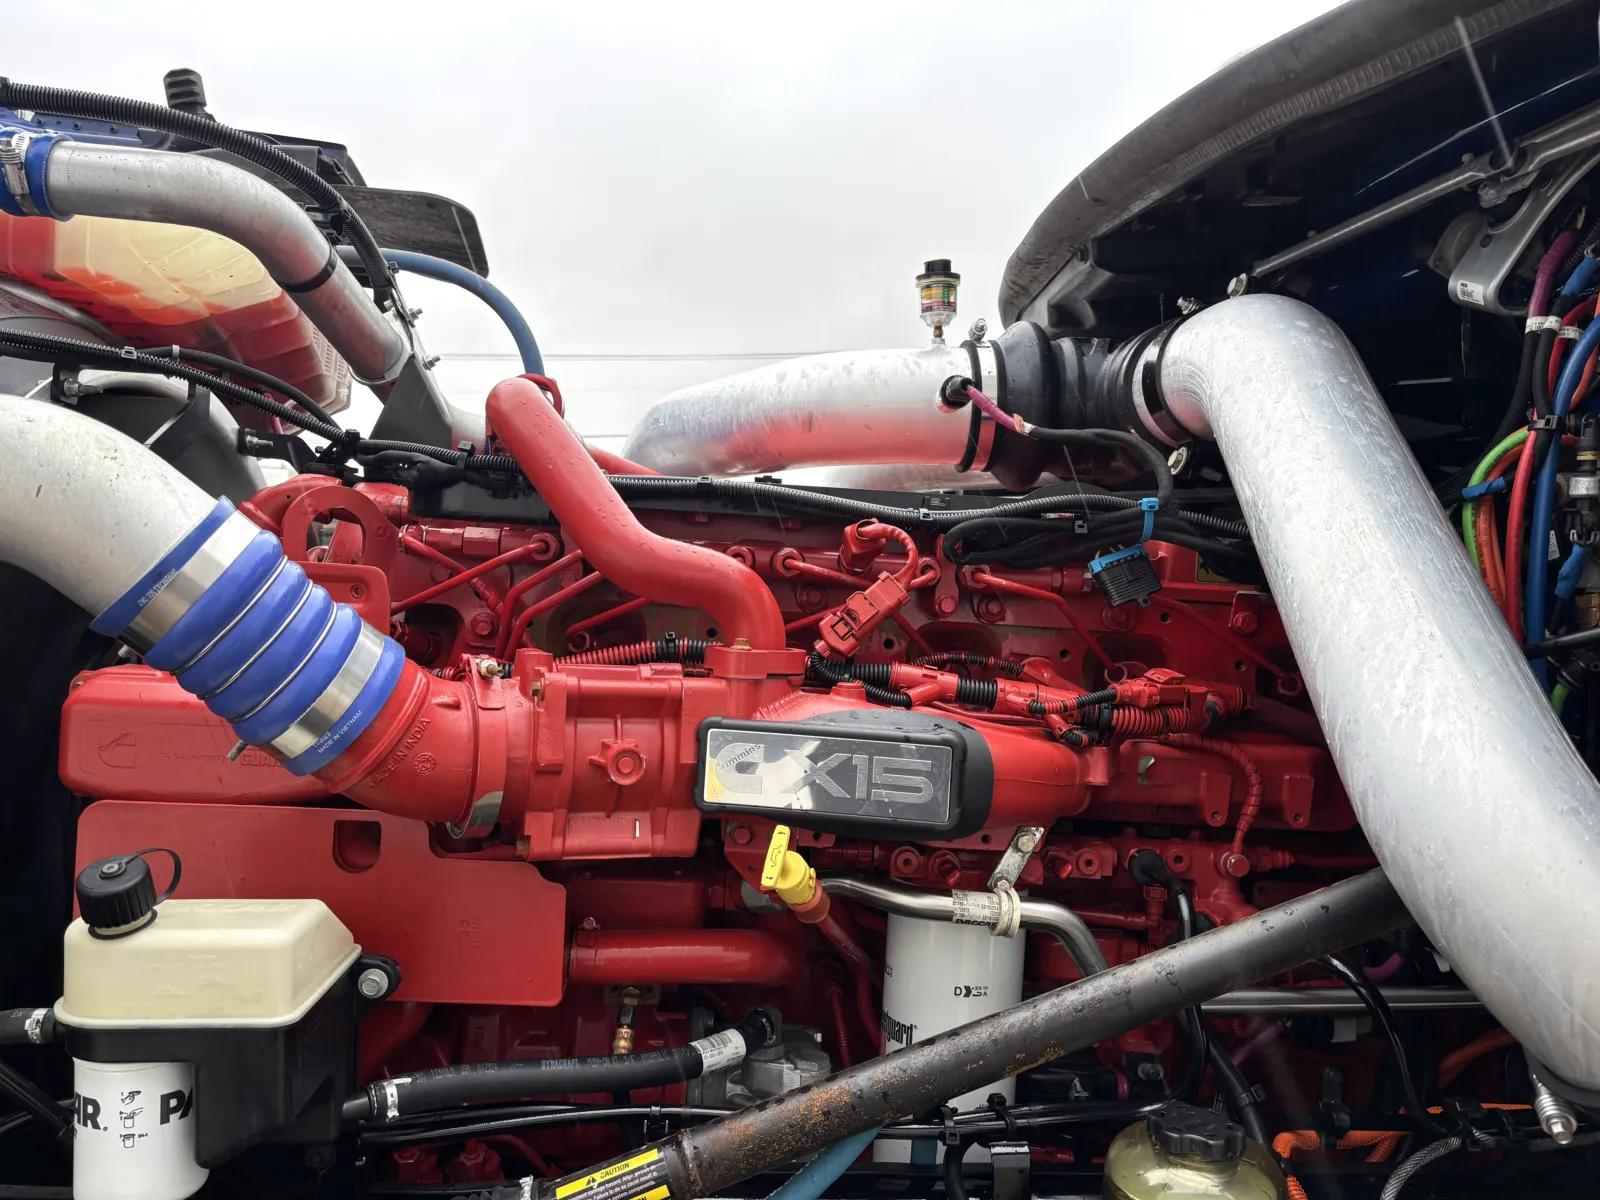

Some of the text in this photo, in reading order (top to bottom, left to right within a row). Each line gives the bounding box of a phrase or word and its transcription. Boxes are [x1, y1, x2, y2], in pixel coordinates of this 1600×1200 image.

[393, 748, 408, 761] IN
[404, 718, 431, 750] INDIA
[600, 1162, 630, 1179] CAUTION
